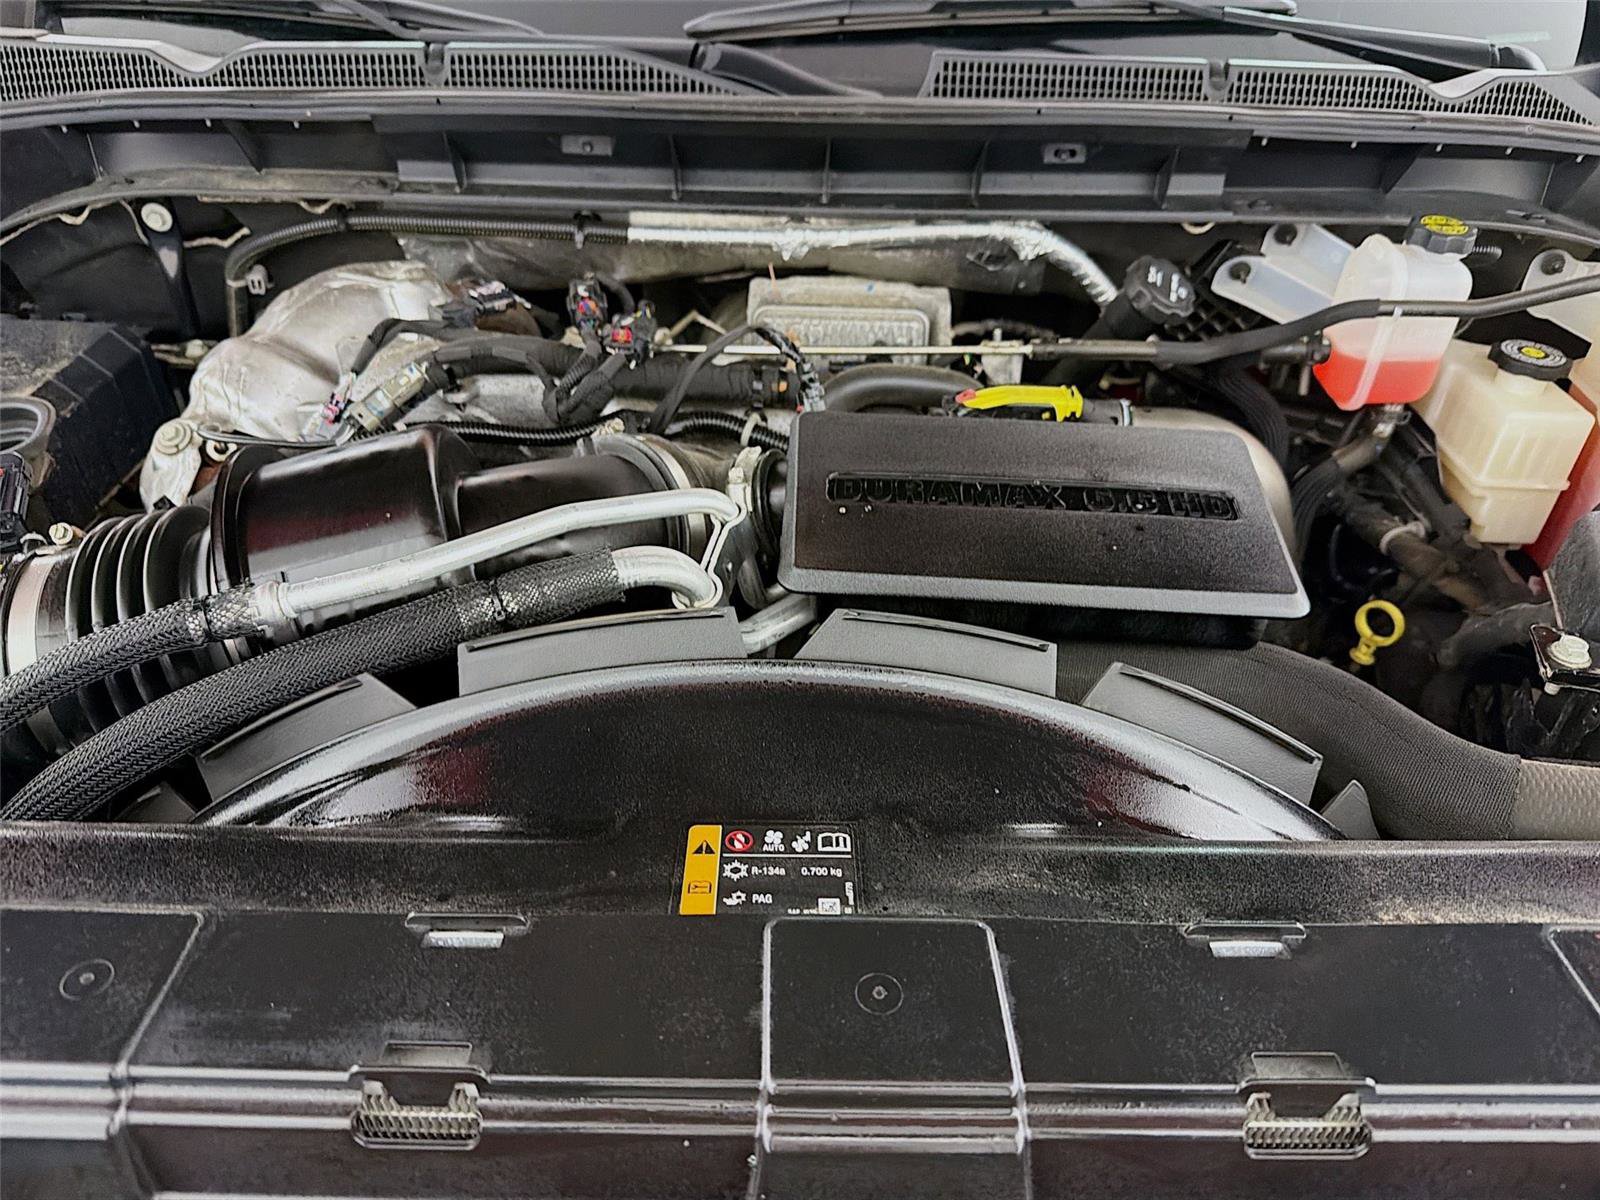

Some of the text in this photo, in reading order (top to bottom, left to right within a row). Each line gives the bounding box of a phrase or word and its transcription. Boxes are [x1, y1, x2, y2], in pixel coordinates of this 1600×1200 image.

[833, 477, 1067, 510] DURAMAX
[762, 843, 785, 852] AUTO
[751, 865, 842, 878] R-134a 0.700 kg
[752, 893, 773, 904] PAG
